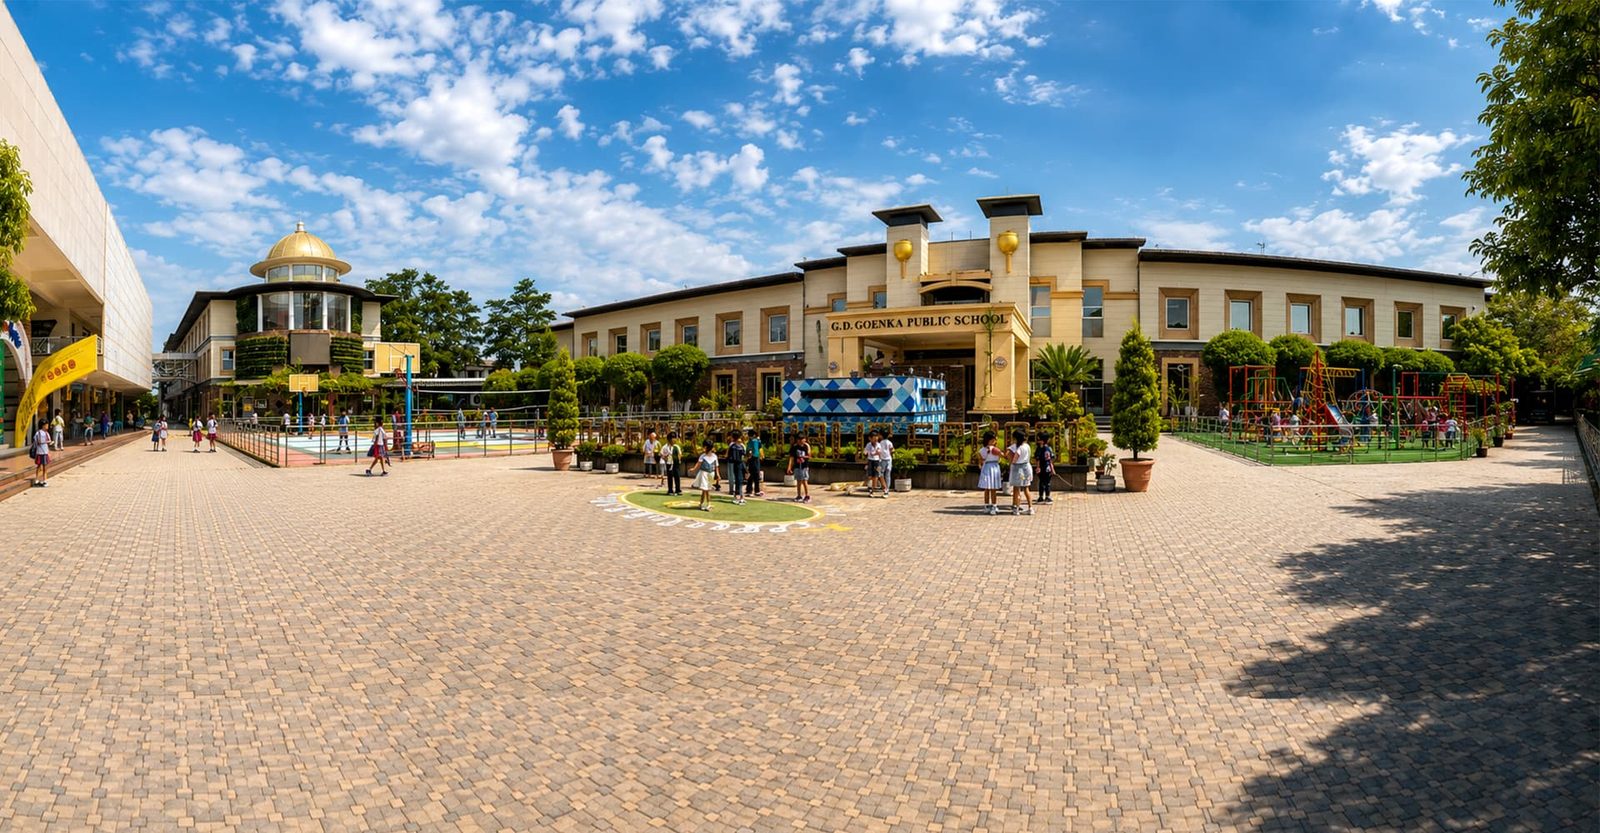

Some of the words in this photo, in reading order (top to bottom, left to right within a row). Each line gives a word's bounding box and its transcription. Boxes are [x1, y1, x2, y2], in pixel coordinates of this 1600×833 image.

[831, 321, 853, 331] G.D.
[855, 319, 903, 329] GOENKA
[907, 317, 951, 327] PUBLIC
[954, 314, 1009, 325] SCHOOL
